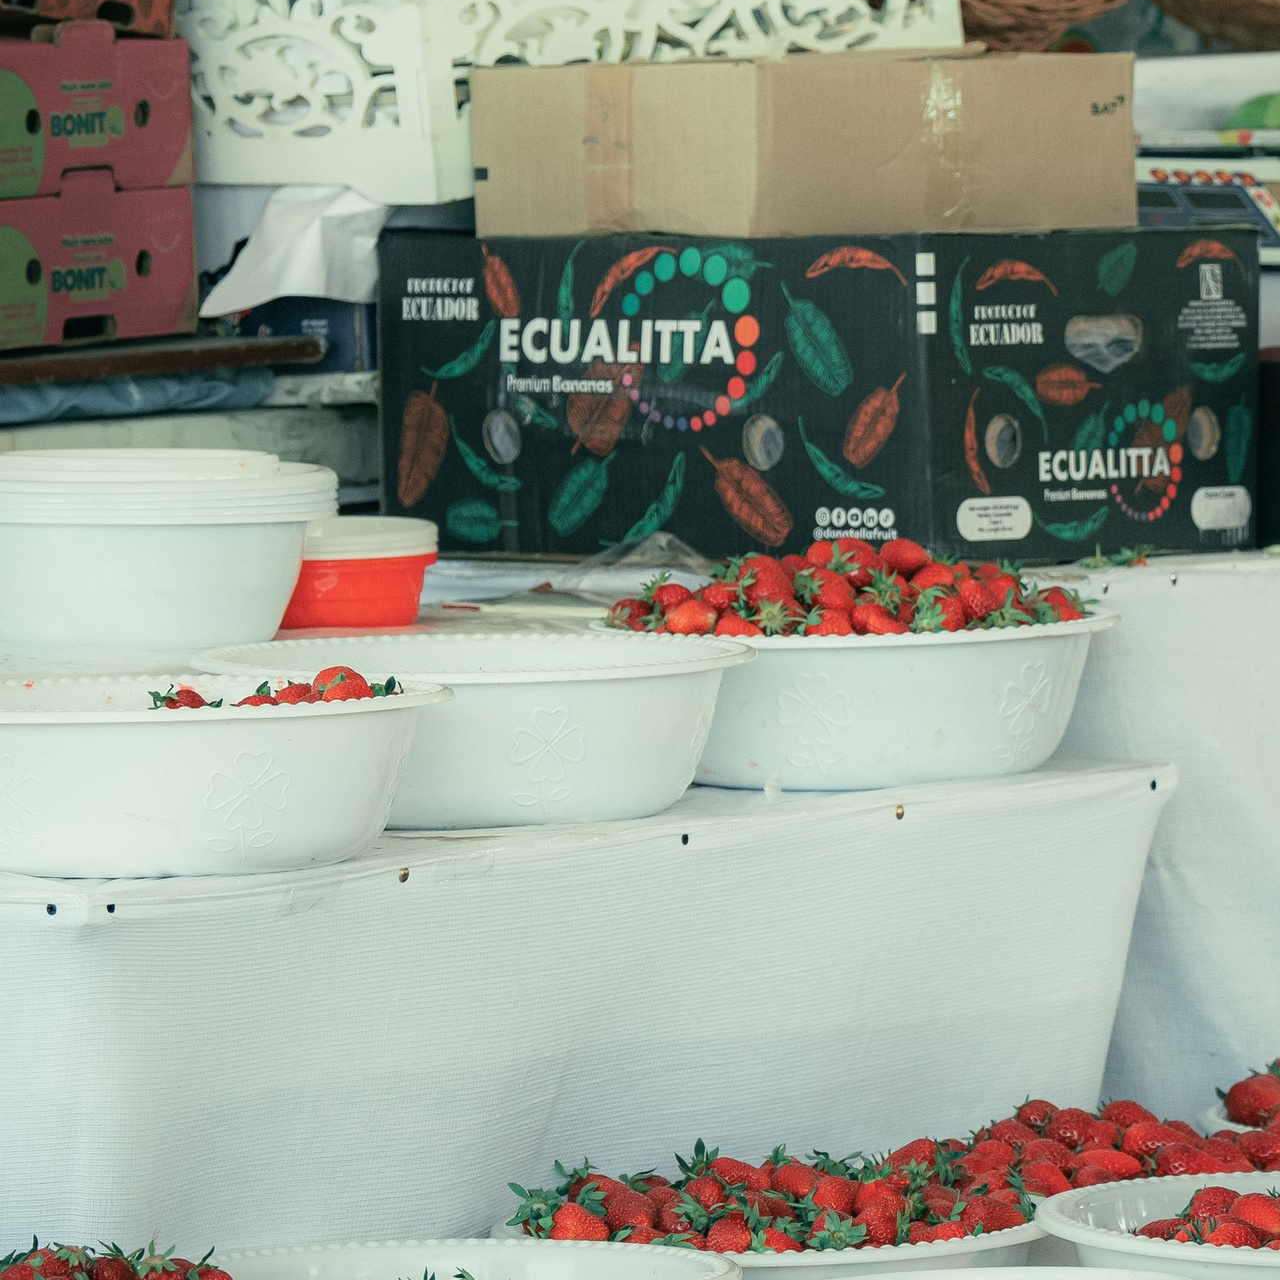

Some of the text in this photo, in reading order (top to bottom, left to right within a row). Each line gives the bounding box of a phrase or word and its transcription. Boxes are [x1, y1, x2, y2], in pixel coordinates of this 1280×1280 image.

[402, 297, 480, 321] ECUADOR
[500, 318, 735, 365] ECUALITTA
[969, 322, 1044, 346] ECUADOR
[506, 374, 614, 394] Premium Bananas
[1038, 446, 1171, 482] ECUALITTA
[1071, 487, 1107, 500] Bananas
[813, 526, 898, 541] @donatellafruit
